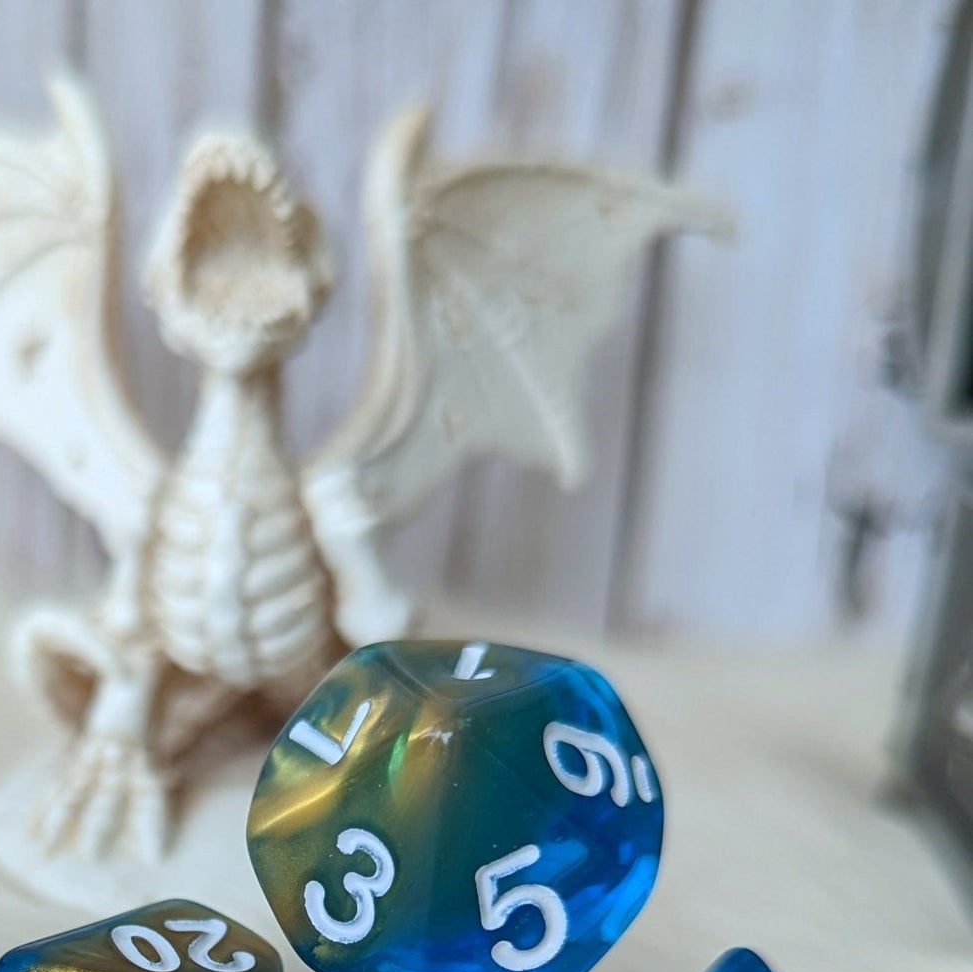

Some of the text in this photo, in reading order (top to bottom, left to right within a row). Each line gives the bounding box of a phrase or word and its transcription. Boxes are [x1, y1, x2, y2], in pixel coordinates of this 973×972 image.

[304, 827, 396, 944] 3
[474, 844, 568, 972] 5
[111, 918, 257, 972] 20
